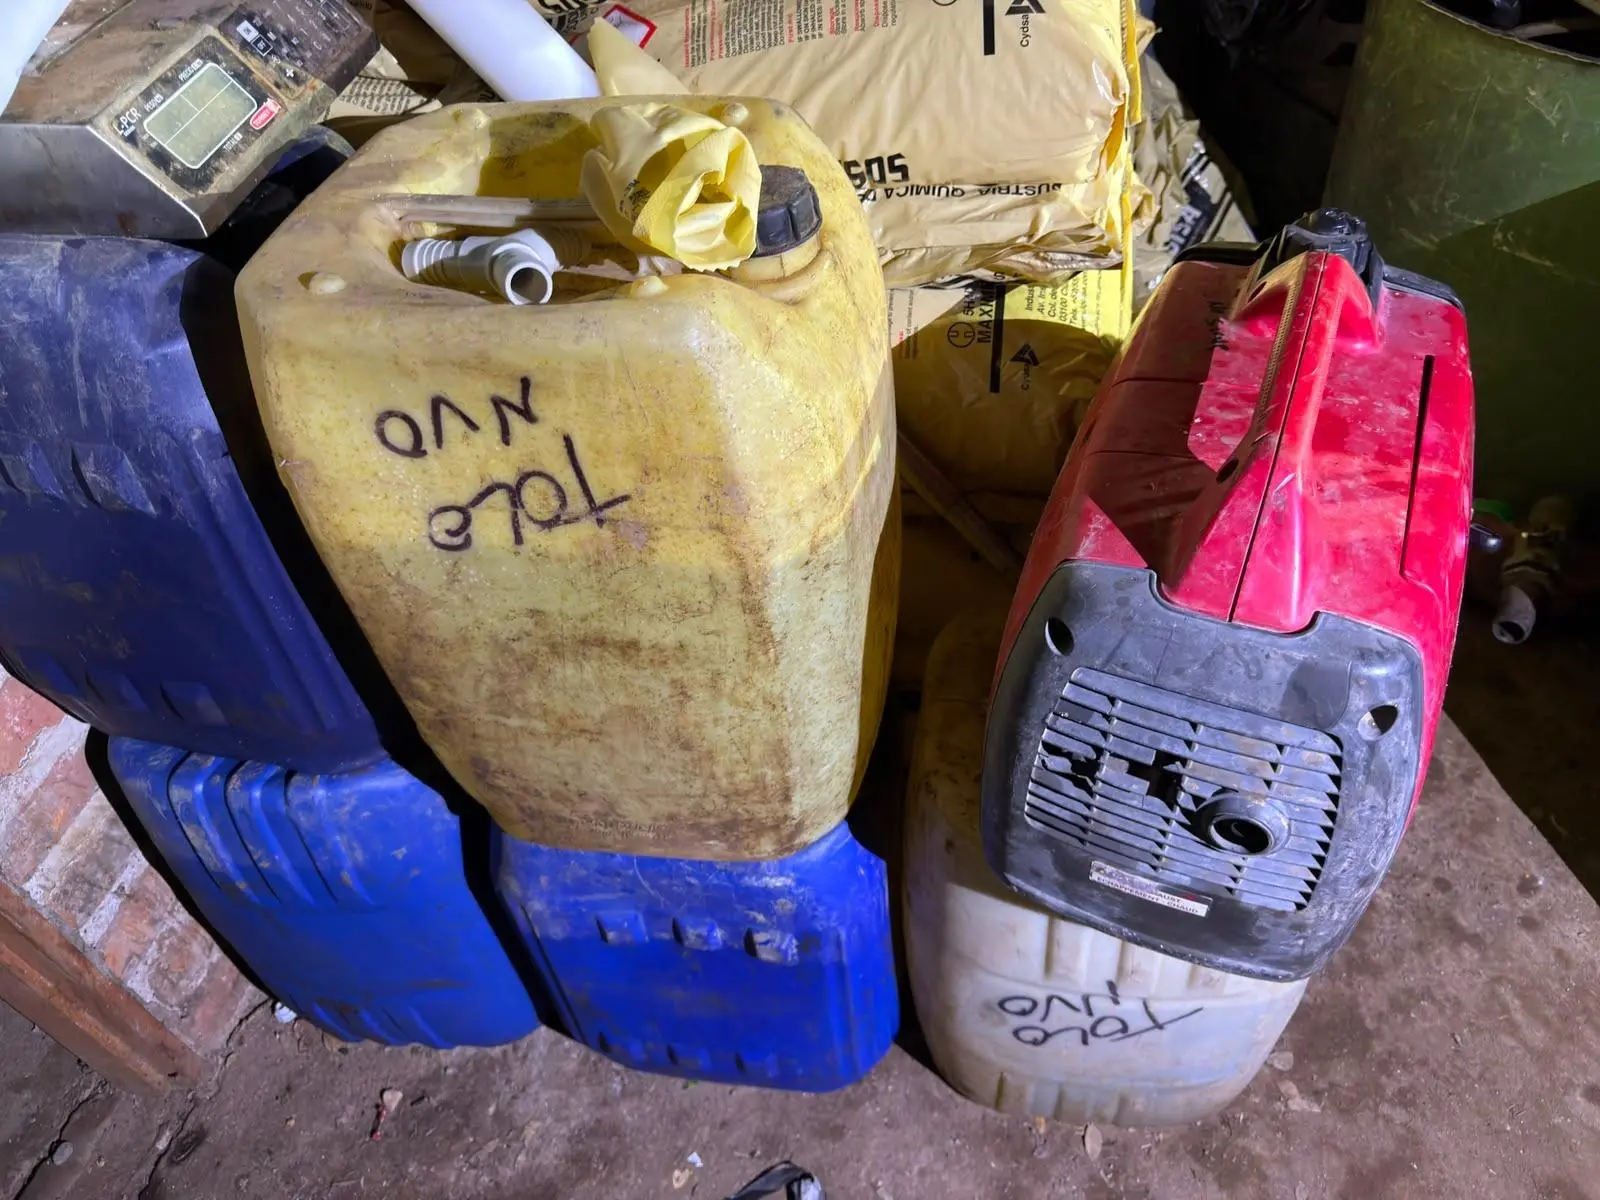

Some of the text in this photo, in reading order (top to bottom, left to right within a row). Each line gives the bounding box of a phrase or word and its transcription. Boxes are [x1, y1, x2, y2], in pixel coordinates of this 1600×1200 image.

[1012, 14, 1024, 48] Cydsa
[884, 184, 966, 199] QUIMICA
[373, 375, 540, 459] NVO
[997, 979, 1120, 1023] NVO
